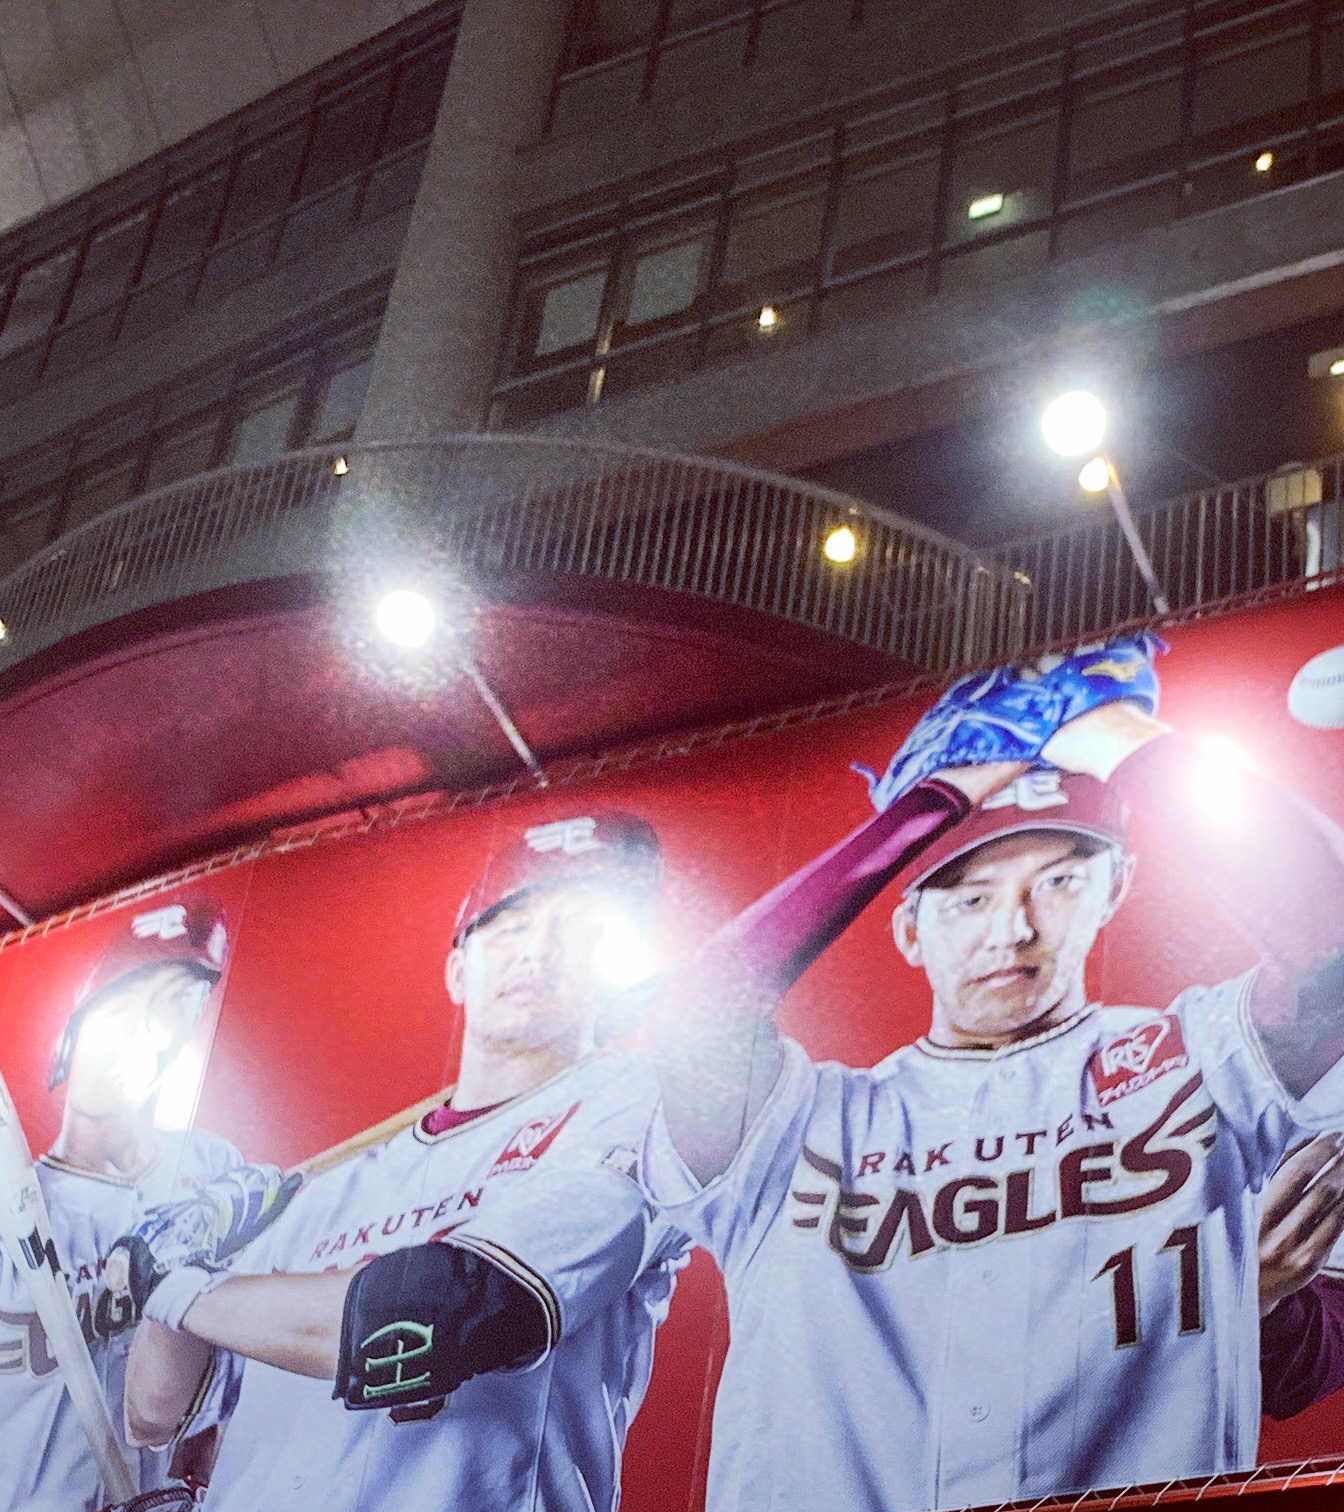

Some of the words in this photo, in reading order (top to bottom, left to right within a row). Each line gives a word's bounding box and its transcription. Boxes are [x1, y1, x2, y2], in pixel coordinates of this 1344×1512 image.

[792, 1070, 1216, 1274] EAGLES
[857, 1112, 1114, 1177] RAKUTEN
[309, 1187, 485, 1262] RAKUTEN
[1091, 1224, 1205, 1349] 11
